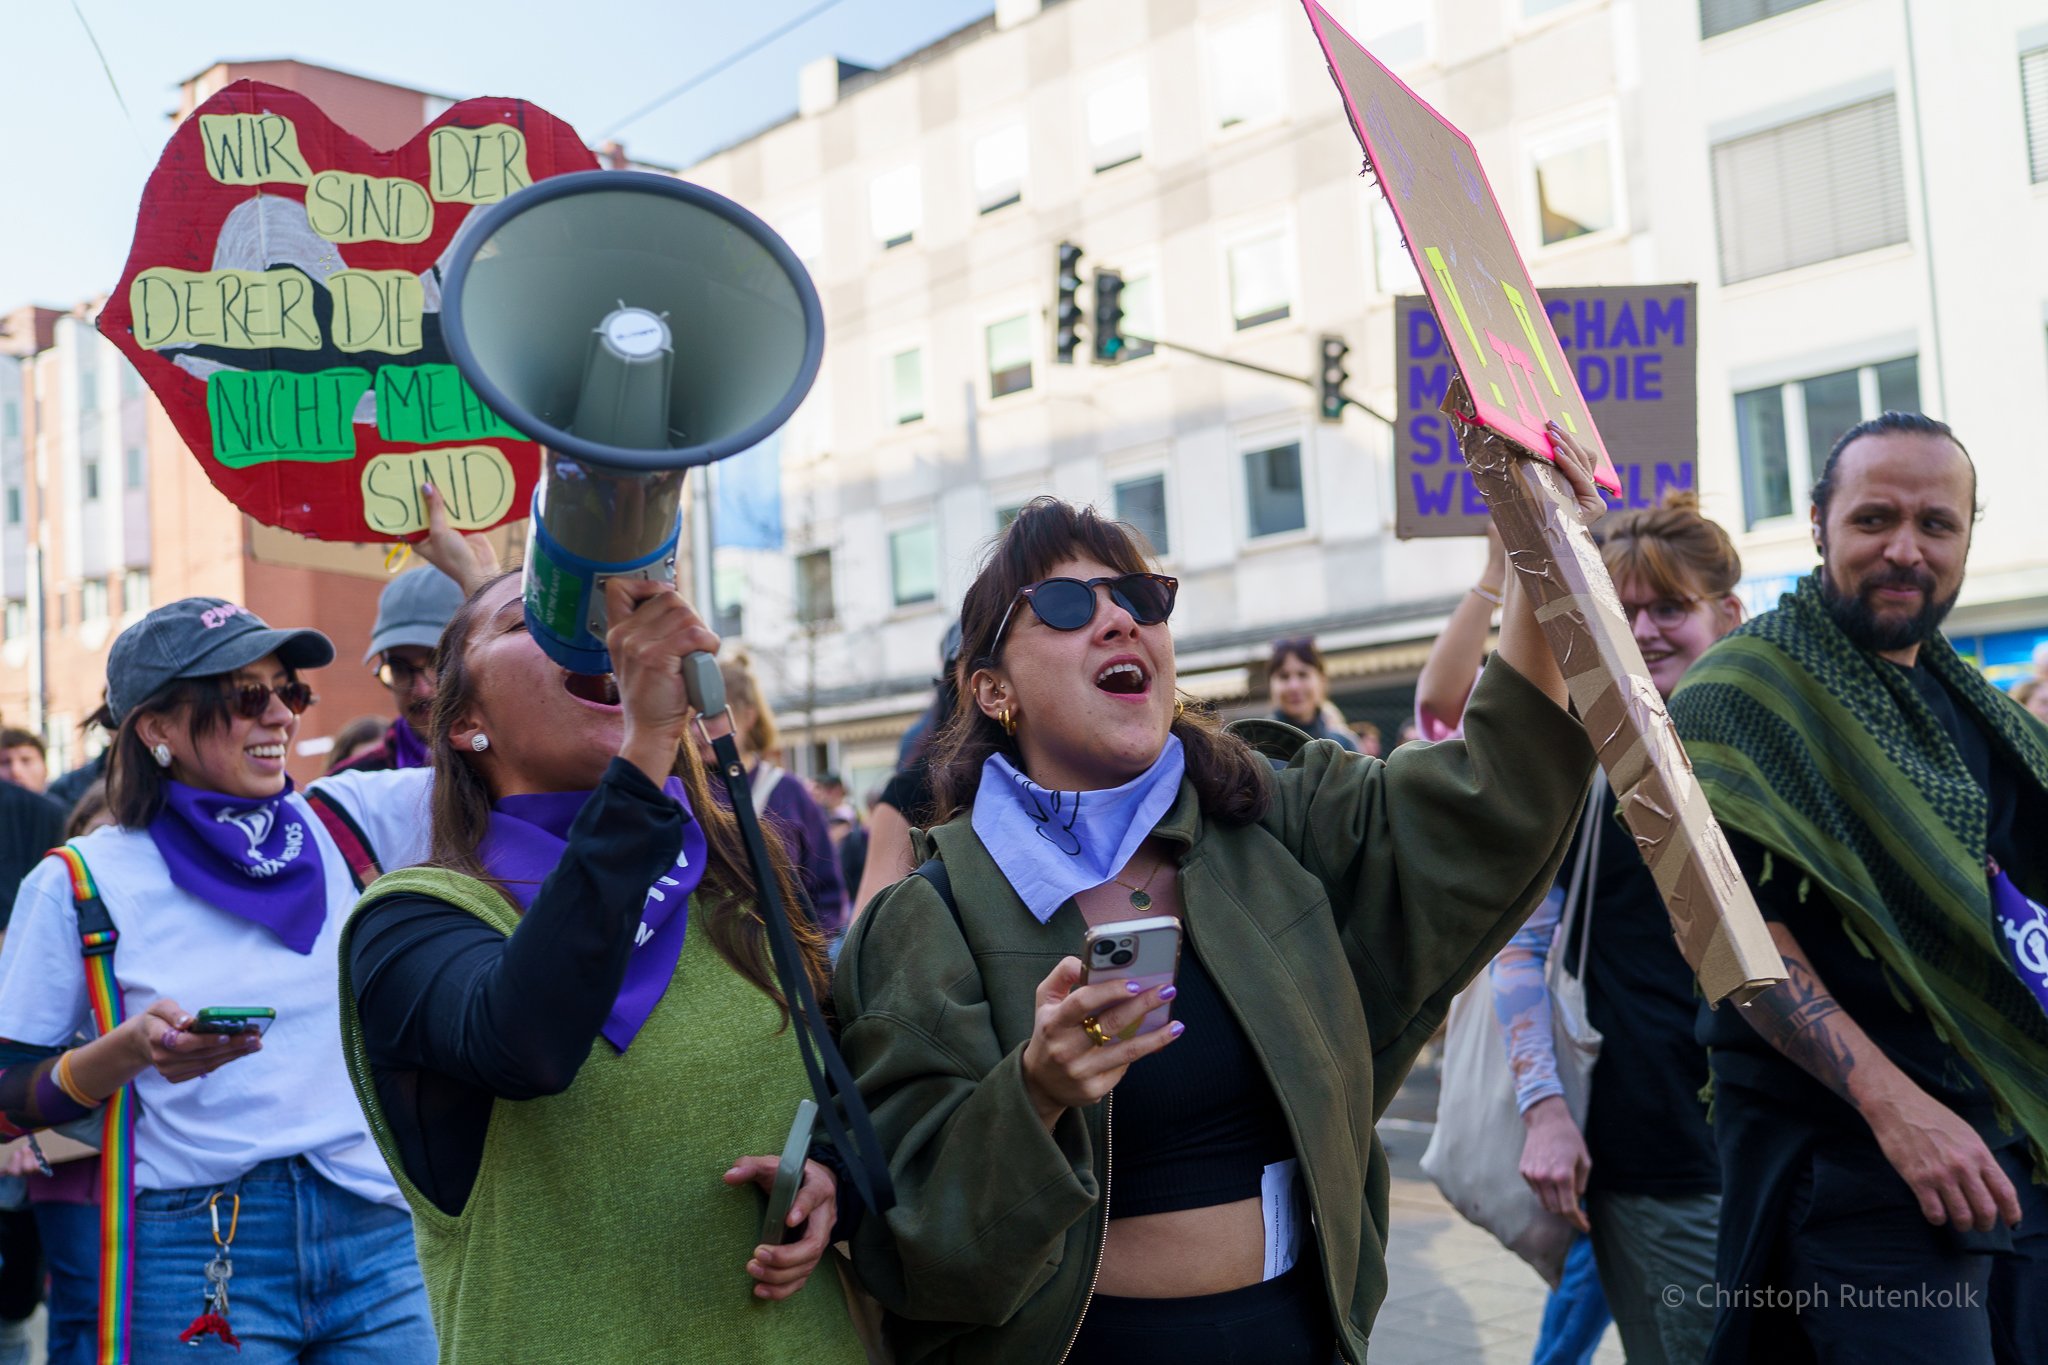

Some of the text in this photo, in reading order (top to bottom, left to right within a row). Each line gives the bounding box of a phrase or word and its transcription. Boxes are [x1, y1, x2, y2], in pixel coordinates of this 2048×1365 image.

[203, 115, 526, 240] WIR SIND DER
[328, 273, 420, 348] DIE
[216, 370, 497, 453] NICHT MEH
[1577, 353, 1663, 402] DIE
[368, 451, 505, 528] SIND
